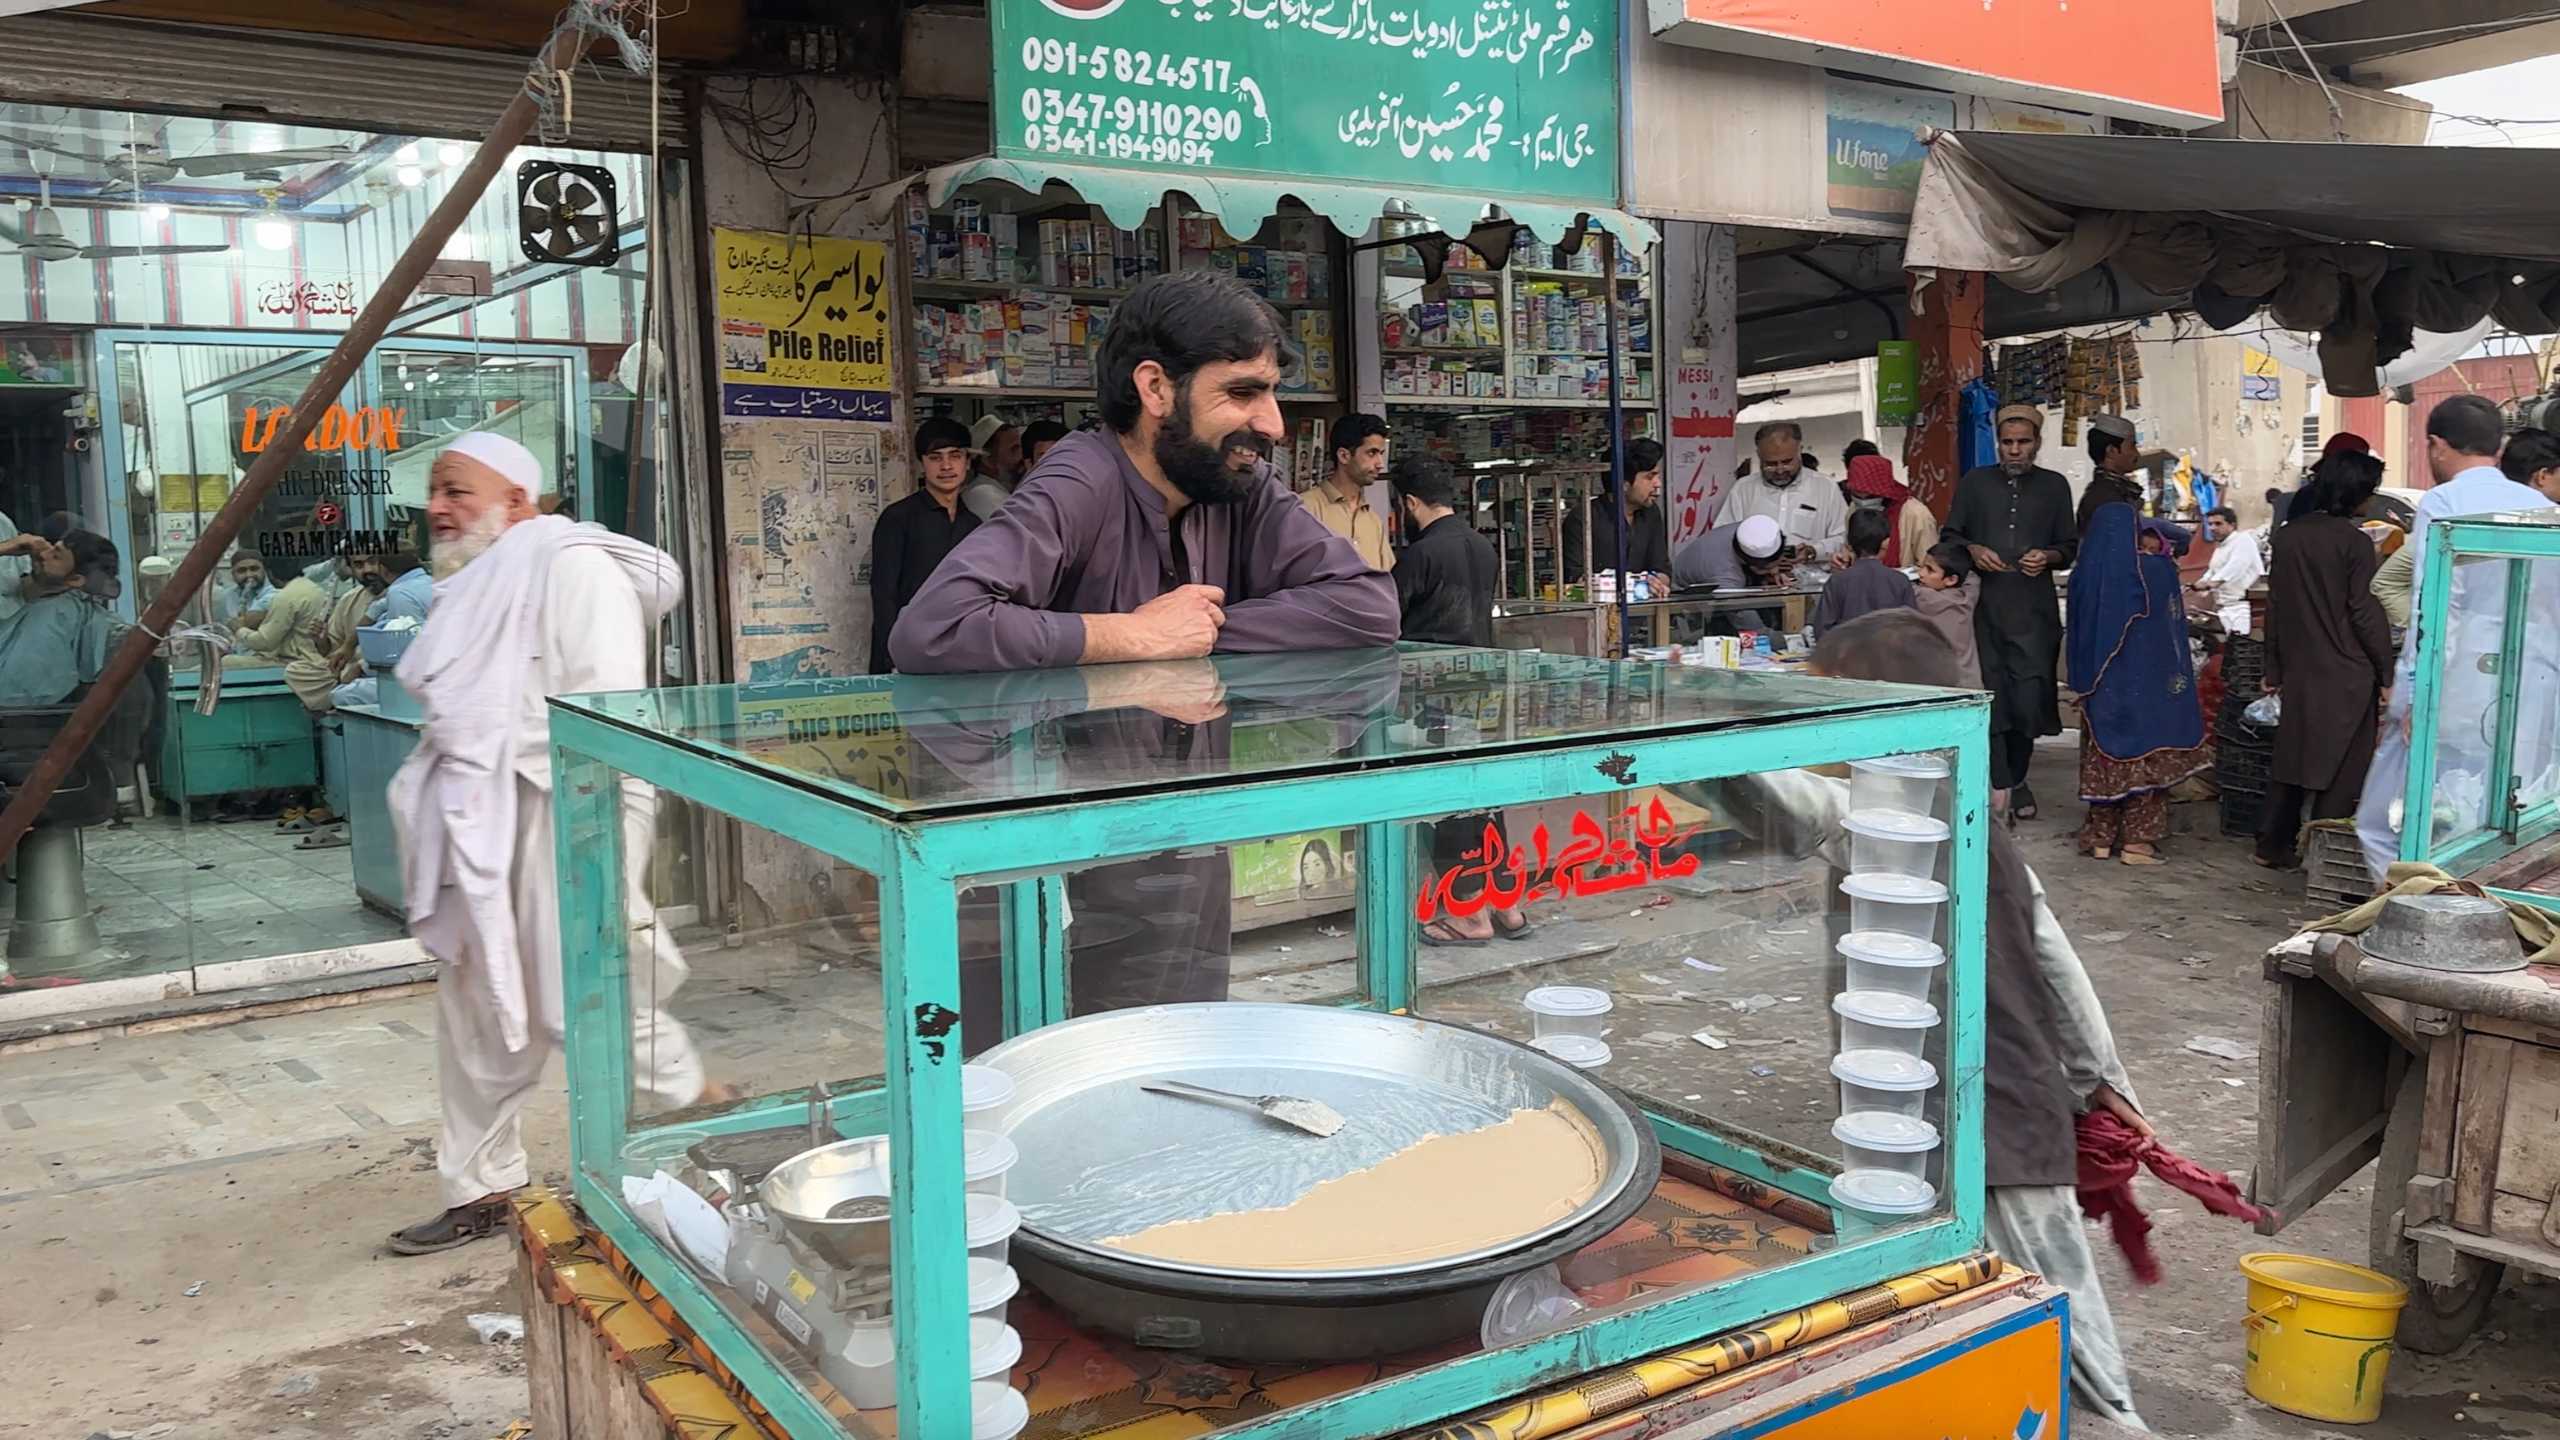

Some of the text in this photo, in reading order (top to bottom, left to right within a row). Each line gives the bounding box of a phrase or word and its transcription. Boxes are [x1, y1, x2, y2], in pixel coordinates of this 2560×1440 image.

[1022, 36, 1232, 93] 091-5824517
[1021, 87, 1242, 142] 0347-9110290
[1024, 123, 1215, 165] 0341-1949094
[1836, 138, 1889, 171] Ufone
[787, 250, 888, 328] بواسیر
[768, 329, 812, 361] Pile
[817, 331, 885, 365] Relief
[1678, 367, 1713, 385] MESSI
[733, 390, 886, 417] یہاں دستیاب ہے
